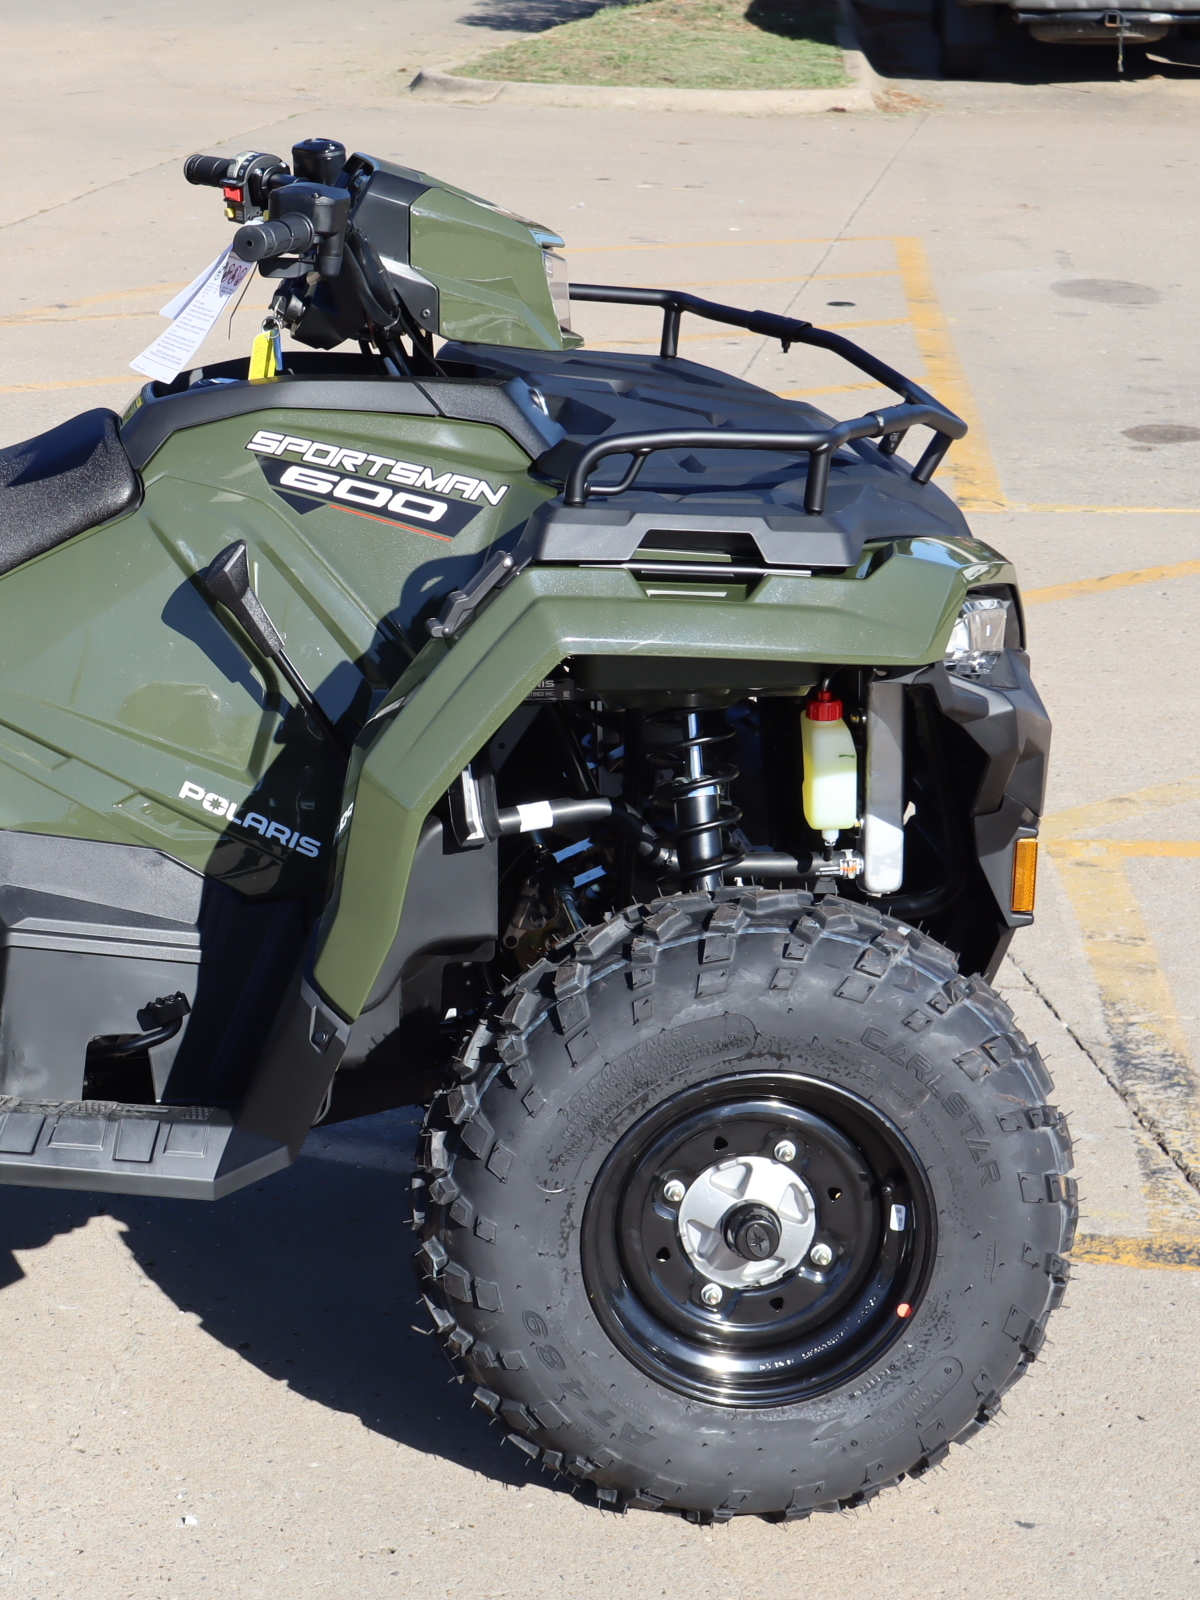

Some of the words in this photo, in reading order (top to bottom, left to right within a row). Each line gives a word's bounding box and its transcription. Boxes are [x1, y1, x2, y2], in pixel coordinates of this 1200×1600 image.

[245, 429, 511, 507] SPORTSMAN
[279, 465, 449, 523] 600
[178, 780, 322, 858] POLARIS
[560, 1116, 581, 1141] NOT
[578, 1094, 599, 1117] FOR
[597, 1055, 645, 1097] HIGHWAY
[649, 1032, 700, 1060] SERVICE
[860, 1024, 1002, 1187] CARLSTAR
